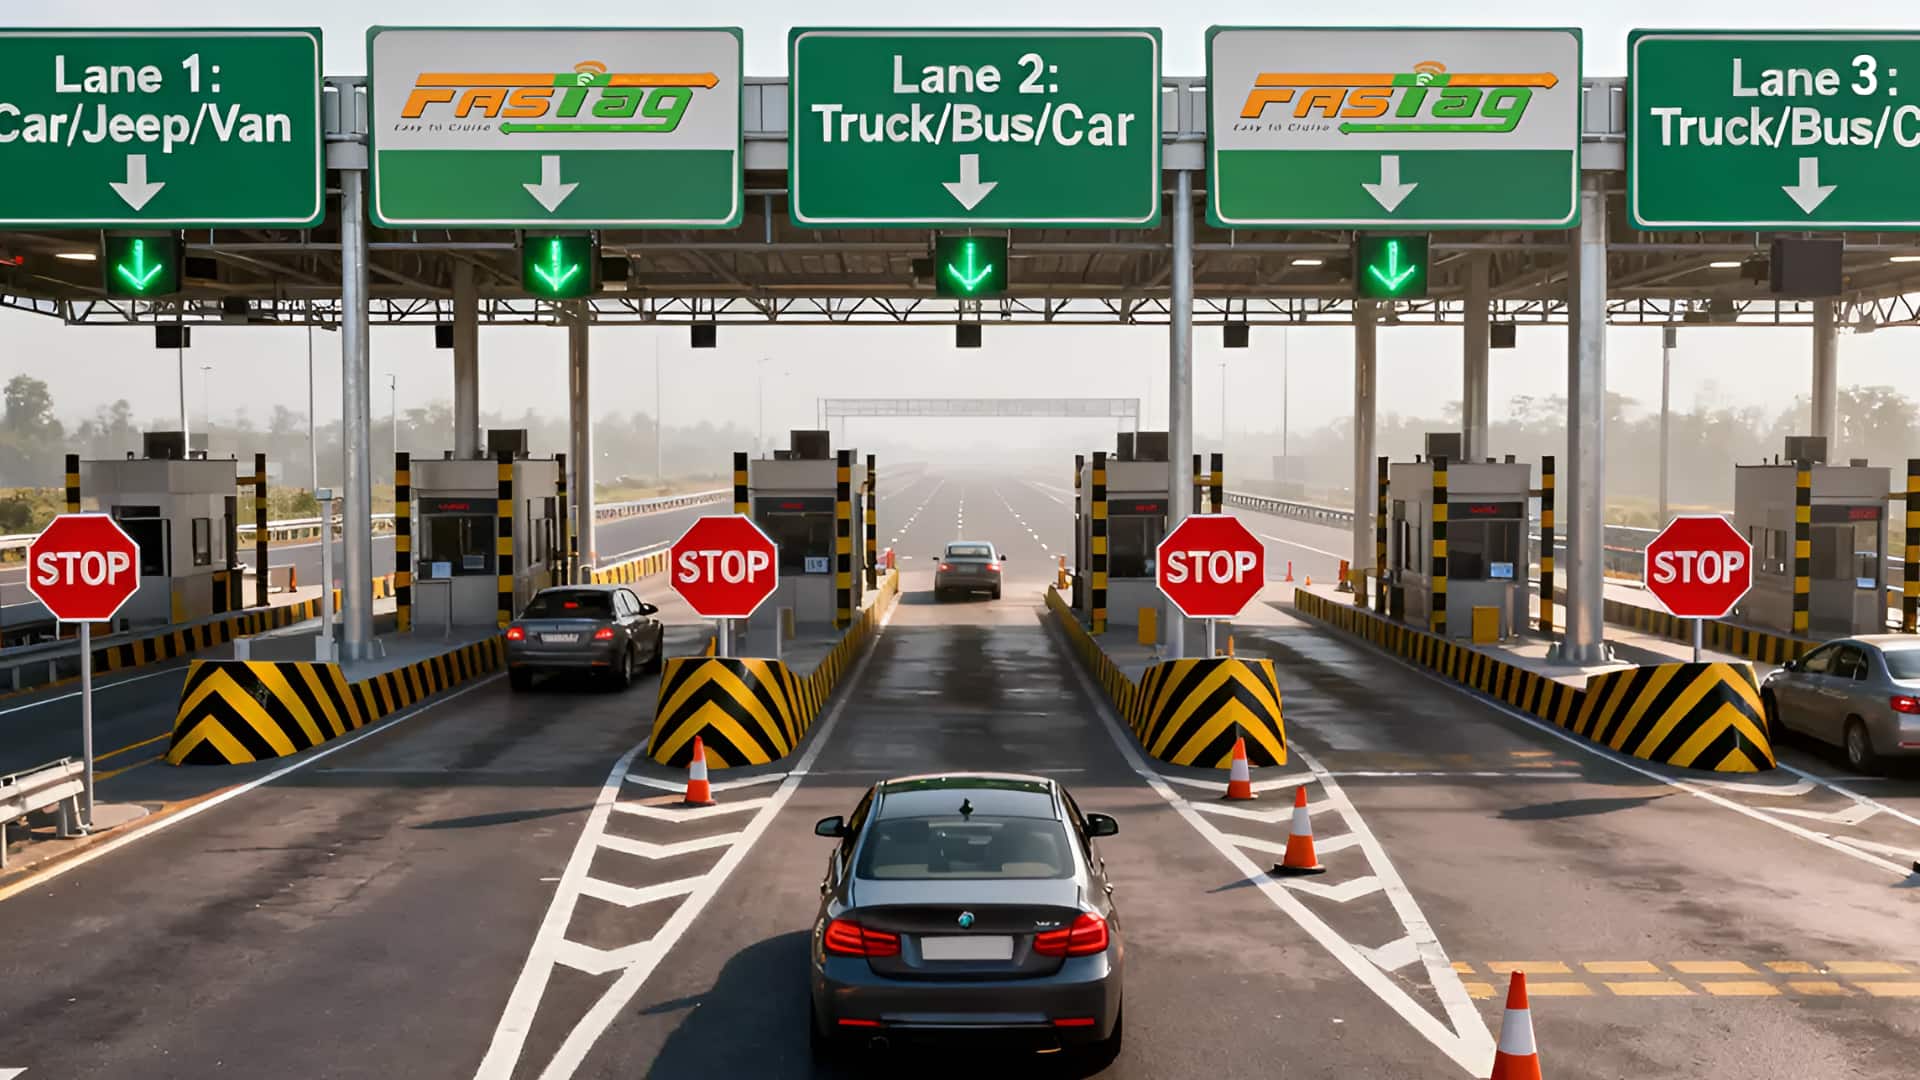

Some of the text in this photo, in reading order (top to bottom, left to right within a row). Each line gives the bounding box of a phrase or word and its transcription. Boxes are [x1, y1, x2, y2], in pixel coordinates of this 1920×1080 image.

[56, 54, 221, 94] Lane 1:
[894, 54, 1058, 94] Lane 2:
[1732, 54, 1897, 96] Lane 3:
[811, 103, 1135, 146] Truck/Bus/Car
[36, 551, 130, 585] STOP
[678, 550, 770, 584] STOP
[1166, 551, 1257, 584] STOP
[1653, 550, 1745, 584] STOP
